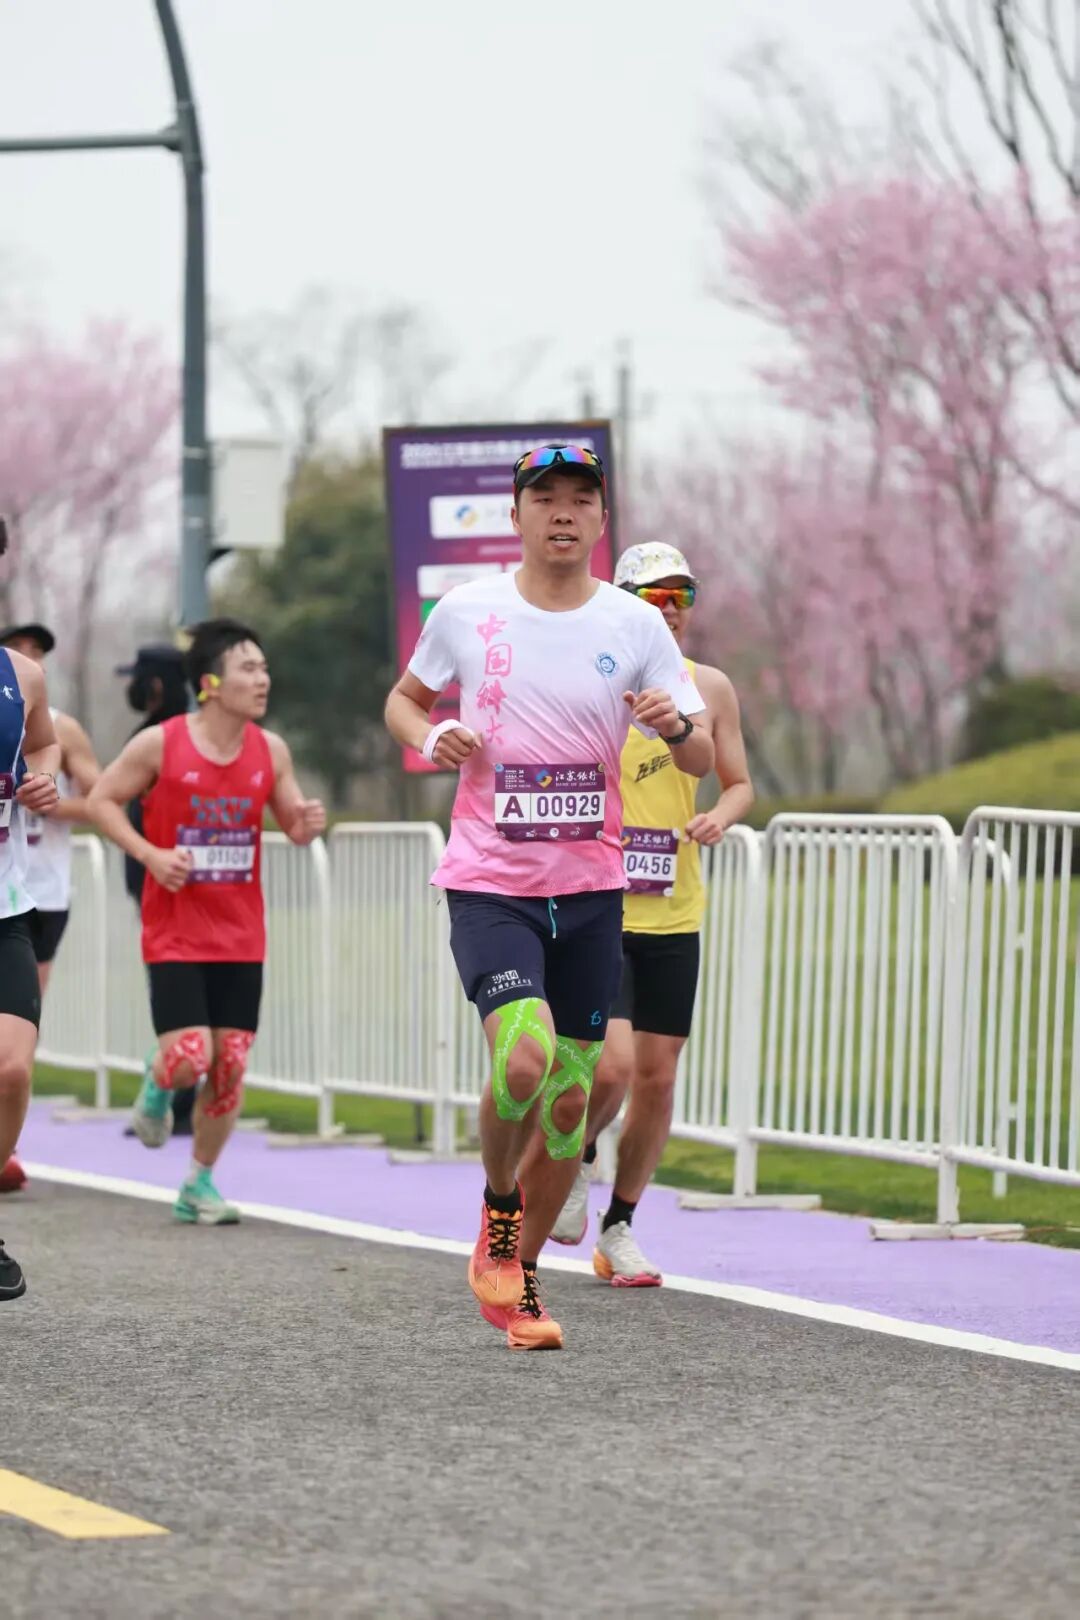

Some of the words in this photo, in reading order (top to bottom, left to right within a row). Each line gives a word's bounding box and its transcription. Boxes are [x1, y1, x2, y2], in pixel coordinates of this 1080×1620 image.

[477, 613, 513, 745] 中国科大
[555, 770, 596, 782] 江苏银行
[502, 795, 525, 818] A
[536, 794, 599, 817] 00929
[626, 854, 672, 875] 0456
